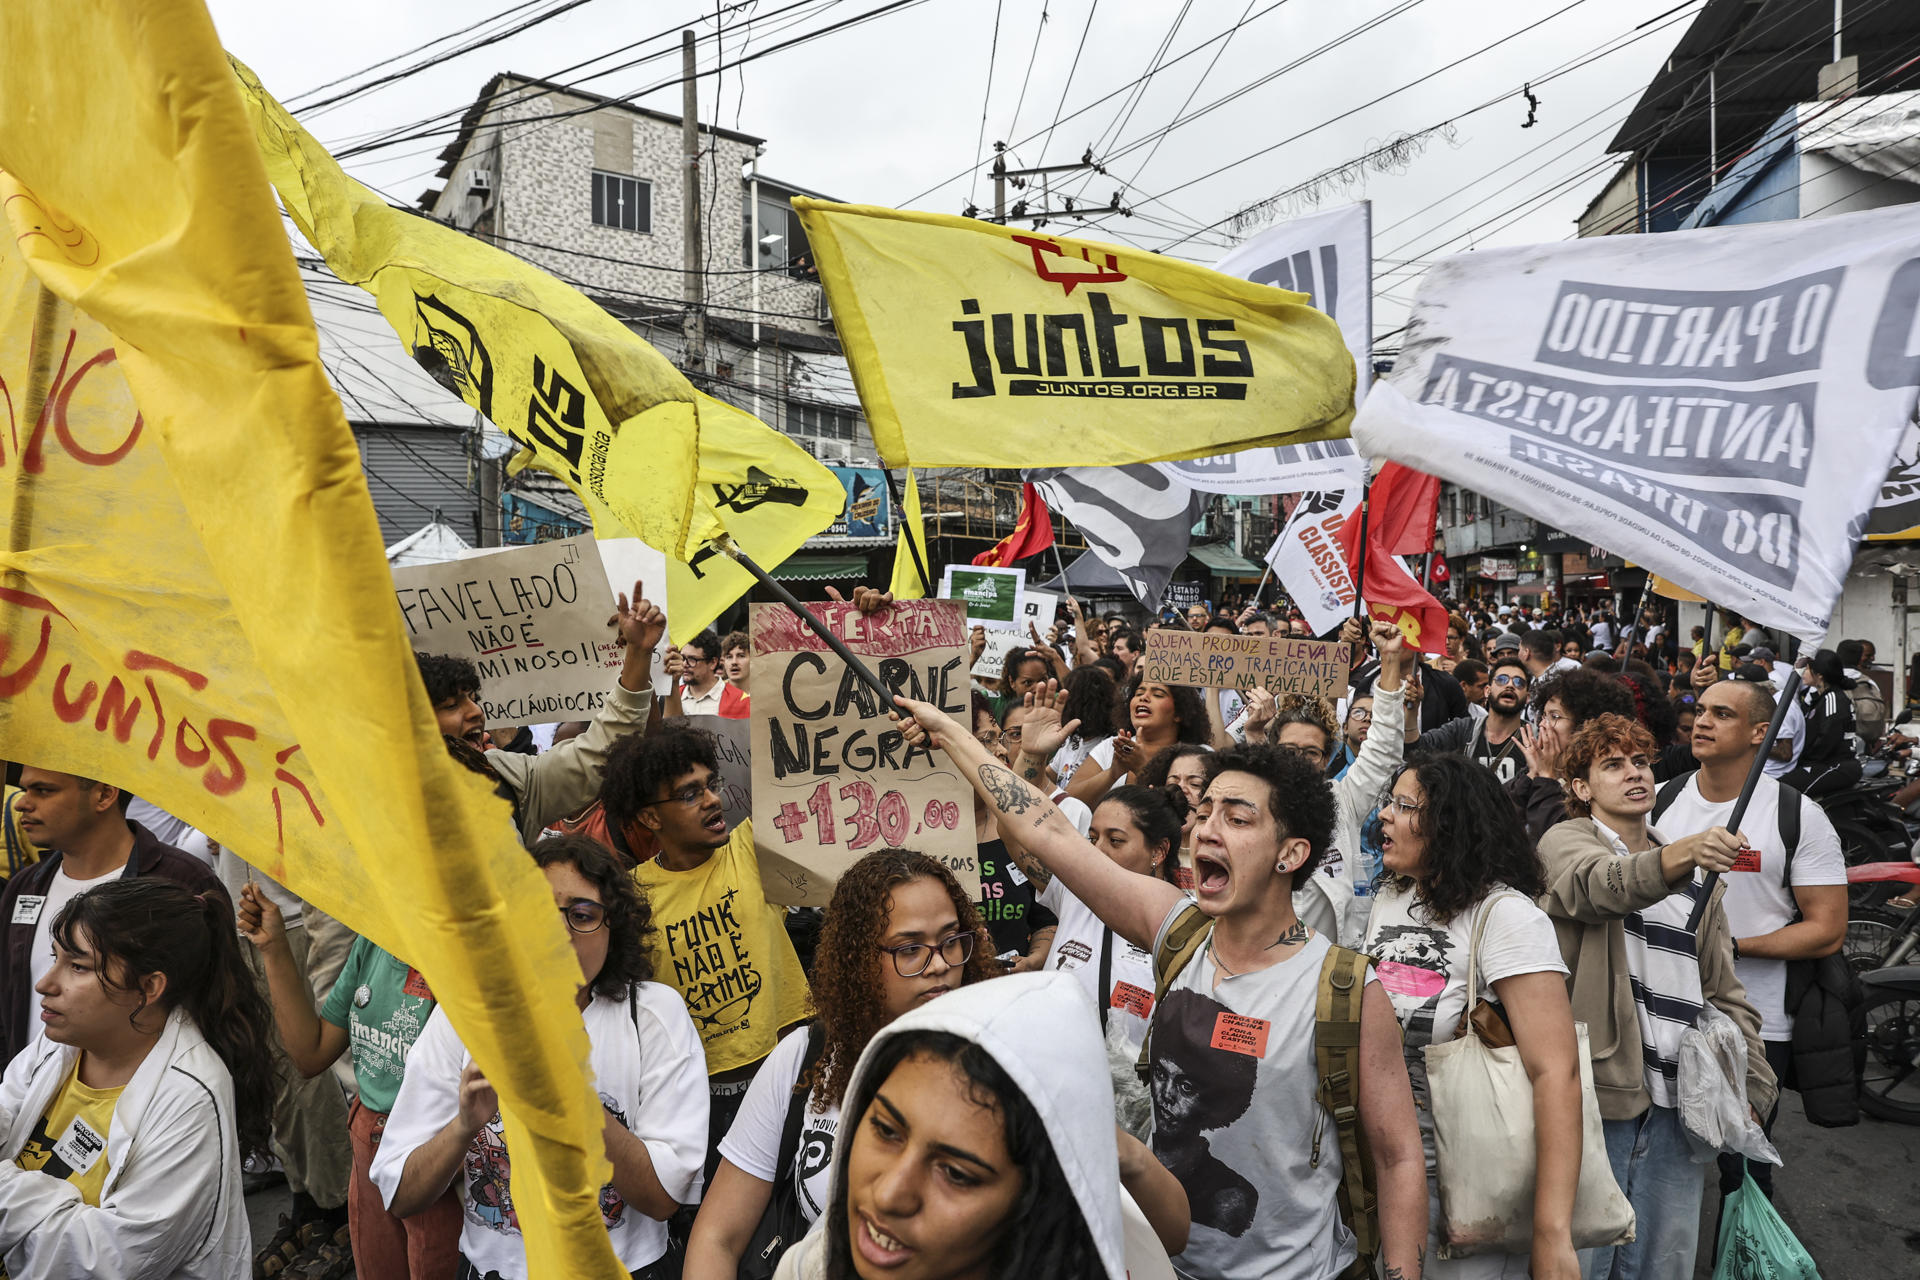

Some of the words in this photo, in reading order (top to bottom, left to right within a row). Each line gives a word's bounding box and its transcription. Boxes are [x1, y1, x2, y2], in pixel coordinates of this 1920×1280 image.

[952, 291, 1254, 399] juntos
[1035, 382, 1218, 398] JUNTOS.ORG.BR
[1297, 525, 1357, 607] CLASSISTA
[397, 563, 578, 635] FAVELADO
[468, 624, 515, 652] NÃO
[519, 613, 540, 644] É
[1150, 633, 1193, 649] QUEM
[1202, 636, 1260, 655] PRODUZ
[1269, 643, 1277, 655] E
[1287, 645, 1327, 661] LEVA
[1334, 647, 1350, 664] AS
[477, 640, 601, 680] MINOSO!!
[1149, 650, 1200, 669] ARMAS
[1208, 654, 1234, 671] PRO
[1245, 657, 1339, 679] TRAFICANTE
[782, 652, 967, 721] CARNE
[1150, 665, 1182, 682] QUE
[1189, 667, 1229, 686] ESTÁ
[1235, 673, 1256, 690] NA
[1265, 674, 1334, 697] FAVELA?
[768, 716, 936, 781] NEGRA
[665, 900, 740, 956] FUNK
[673, 943, 725, 986] NÃO
[729, 931, 749, 963] É
[684, 962, 758, 1011] CRIME
[1222, 1019, 1263, 1031] CHACINA
[1223, 1014, 1251, 1023] CHEGA
[1229, 1027, 1253, 1036] FORA
[384, 1060, 405, 1081] Pop
[710, 1082, 733, 1099] vin
